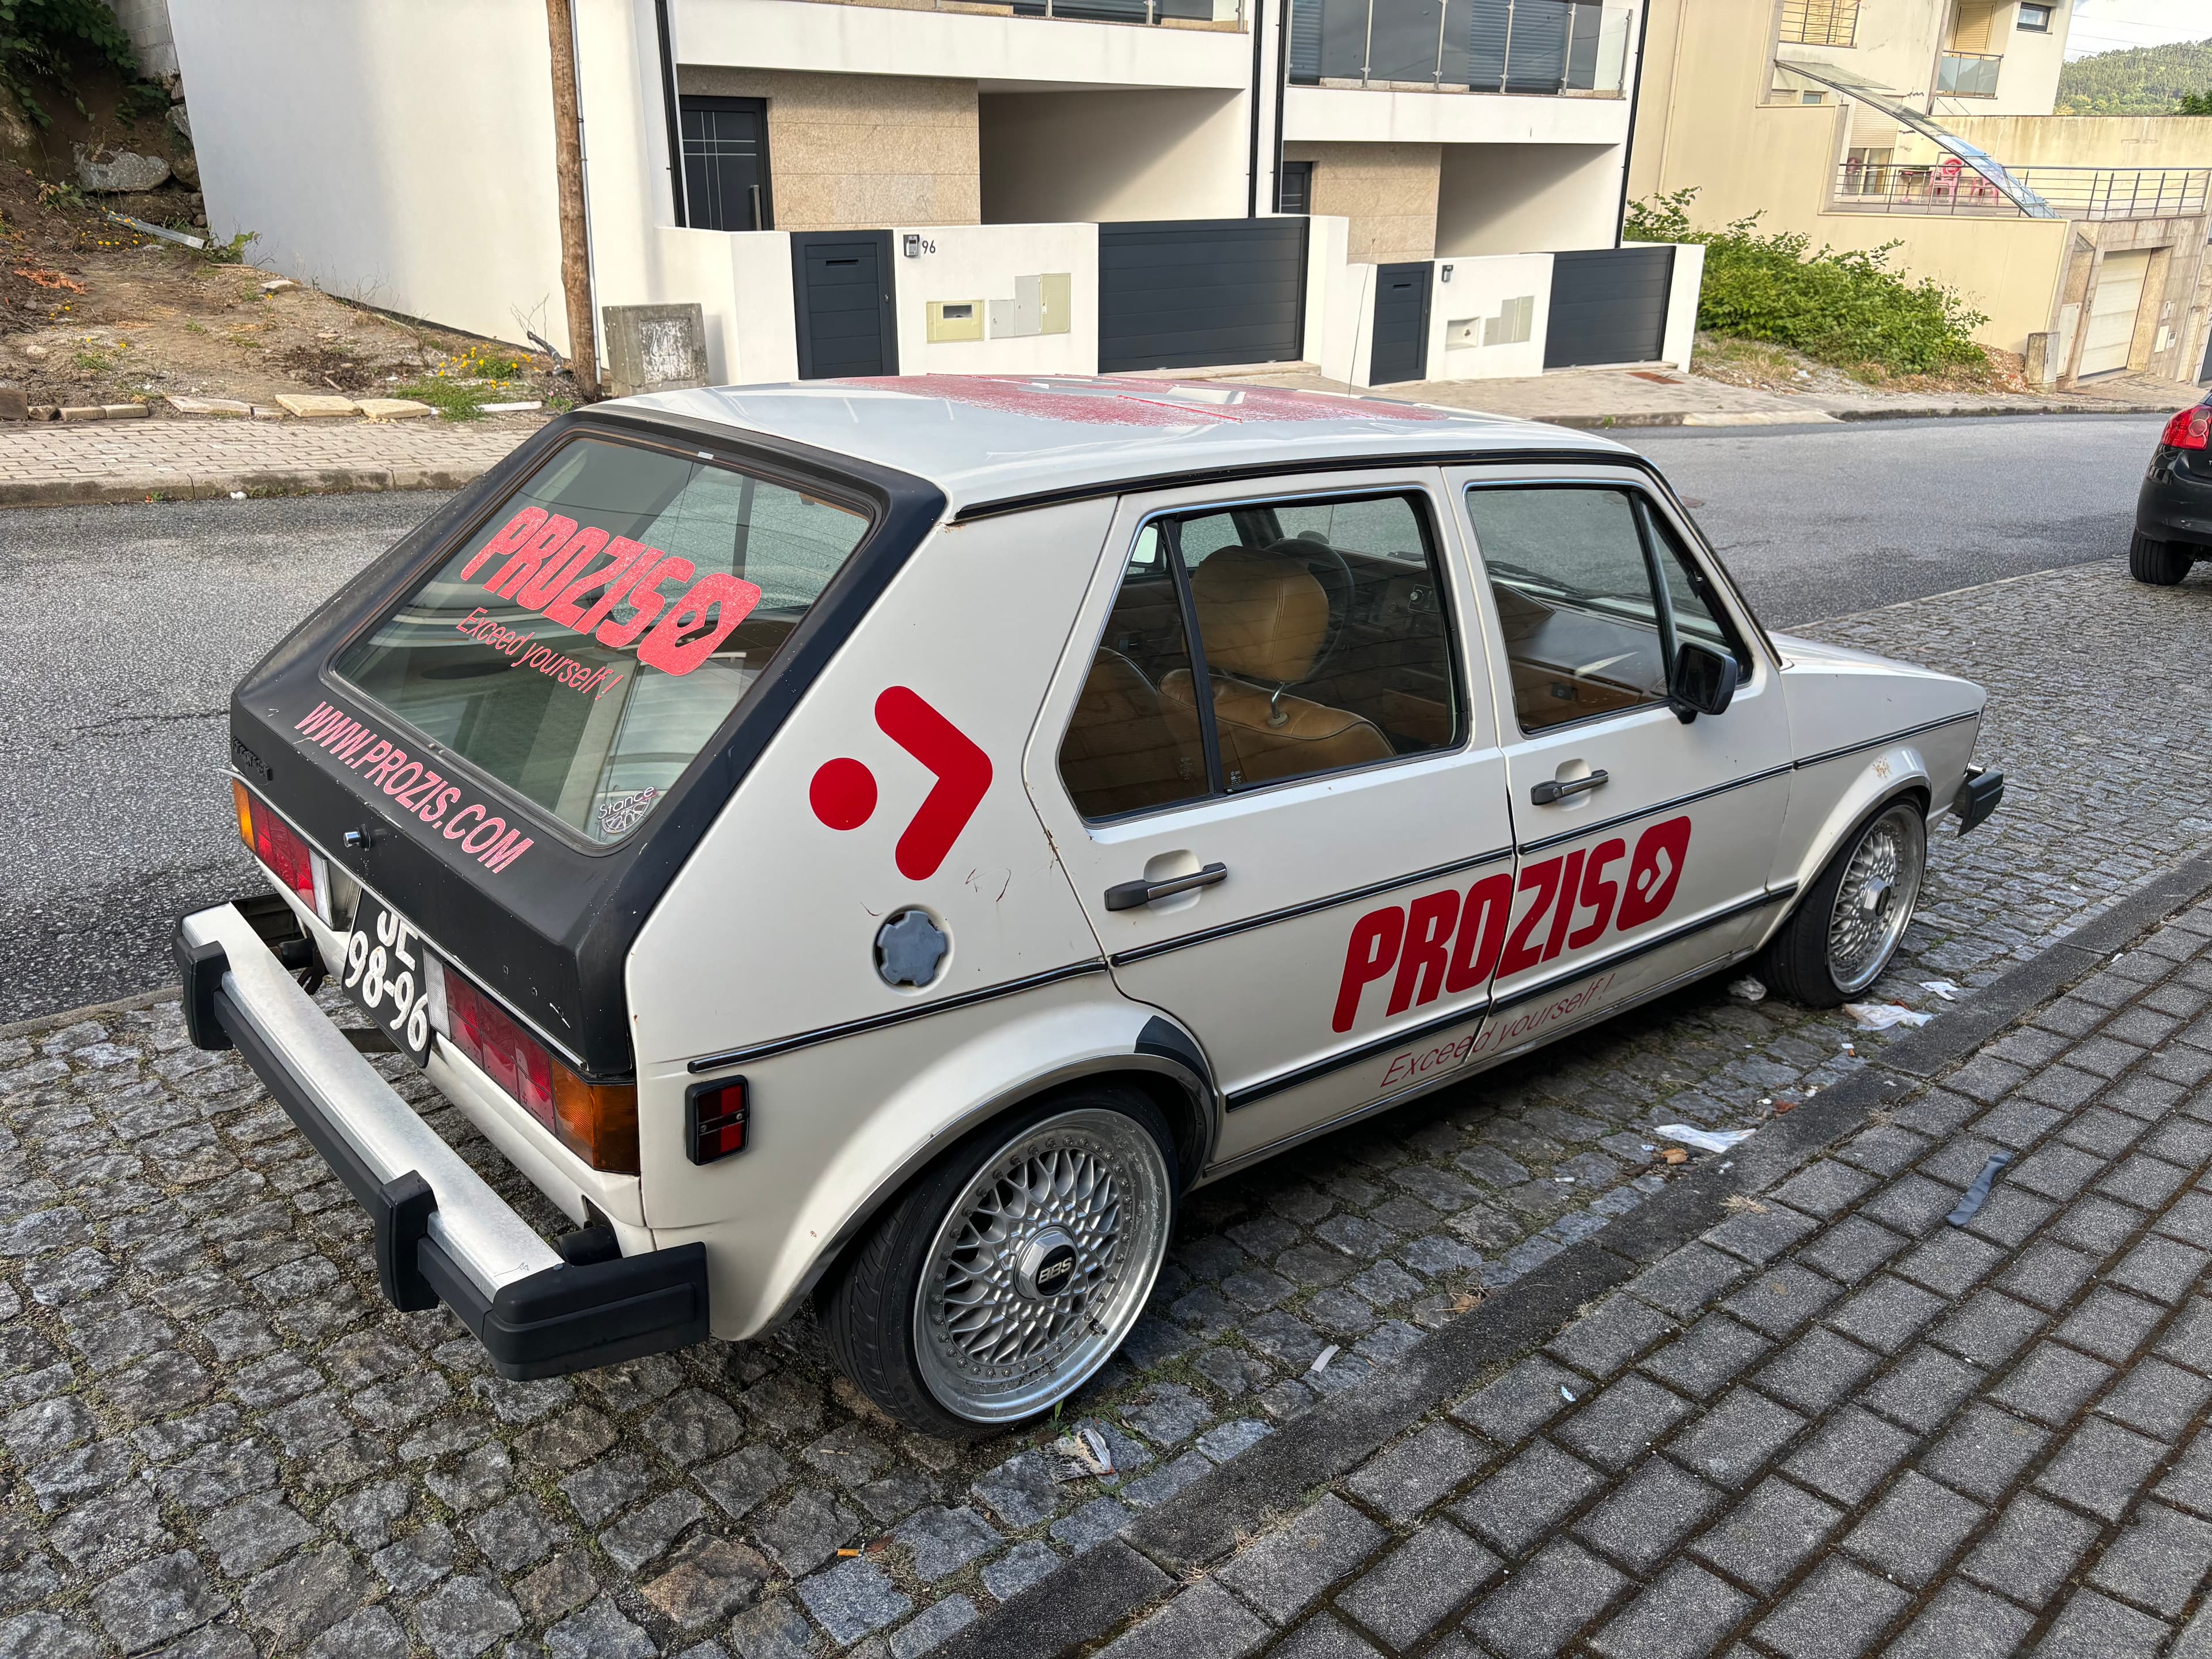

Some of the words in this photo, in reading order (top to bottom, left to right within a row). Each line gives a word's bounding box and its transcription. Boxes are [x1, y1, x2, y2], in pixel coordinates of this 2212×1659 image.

[922, 240, 936, 254] 96
[456, 607, 535, 656] Exceed
[294, 701, 535, 874] WWW.PROZIS.COM
[597, 786, 655, 820] Stance
[344, 930, 429, 1052] 98-96
[1380, 1022, 1498, 1088] Exceed
[1037, 1256, 1073, 1285] BBS
